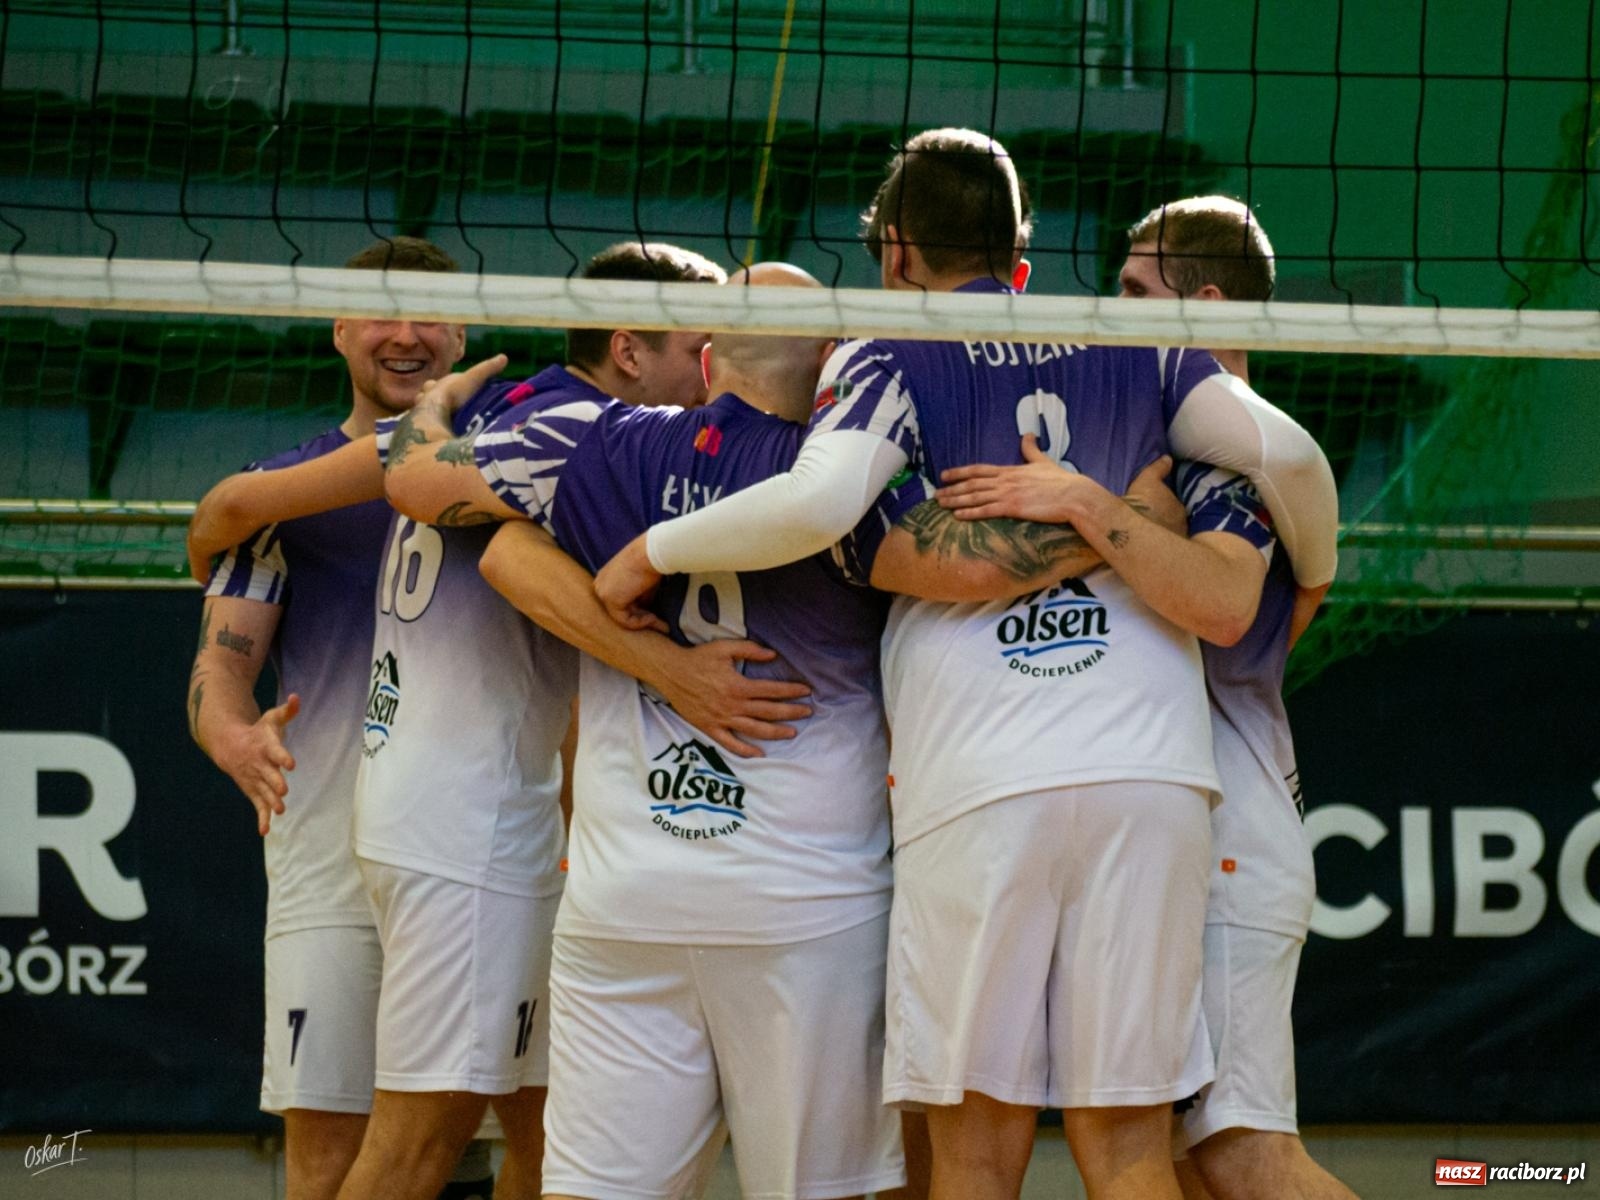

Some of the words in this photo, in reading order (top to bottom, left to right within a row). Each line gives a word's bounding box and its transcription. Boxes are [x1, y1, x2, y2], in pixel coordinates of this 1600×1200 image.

[380, 511, 446, 622] 16
[996, 603, 1111, 645] olsen
[1008, 648, 1106, 678] DOCIEPLENIA
[365, 680, 400, 727] lsen
[647, 762, 746, 810] olsen
[651, 813, 742, 841] DOCIEPLENIA
[287, 1008, 307, 1068] 7
